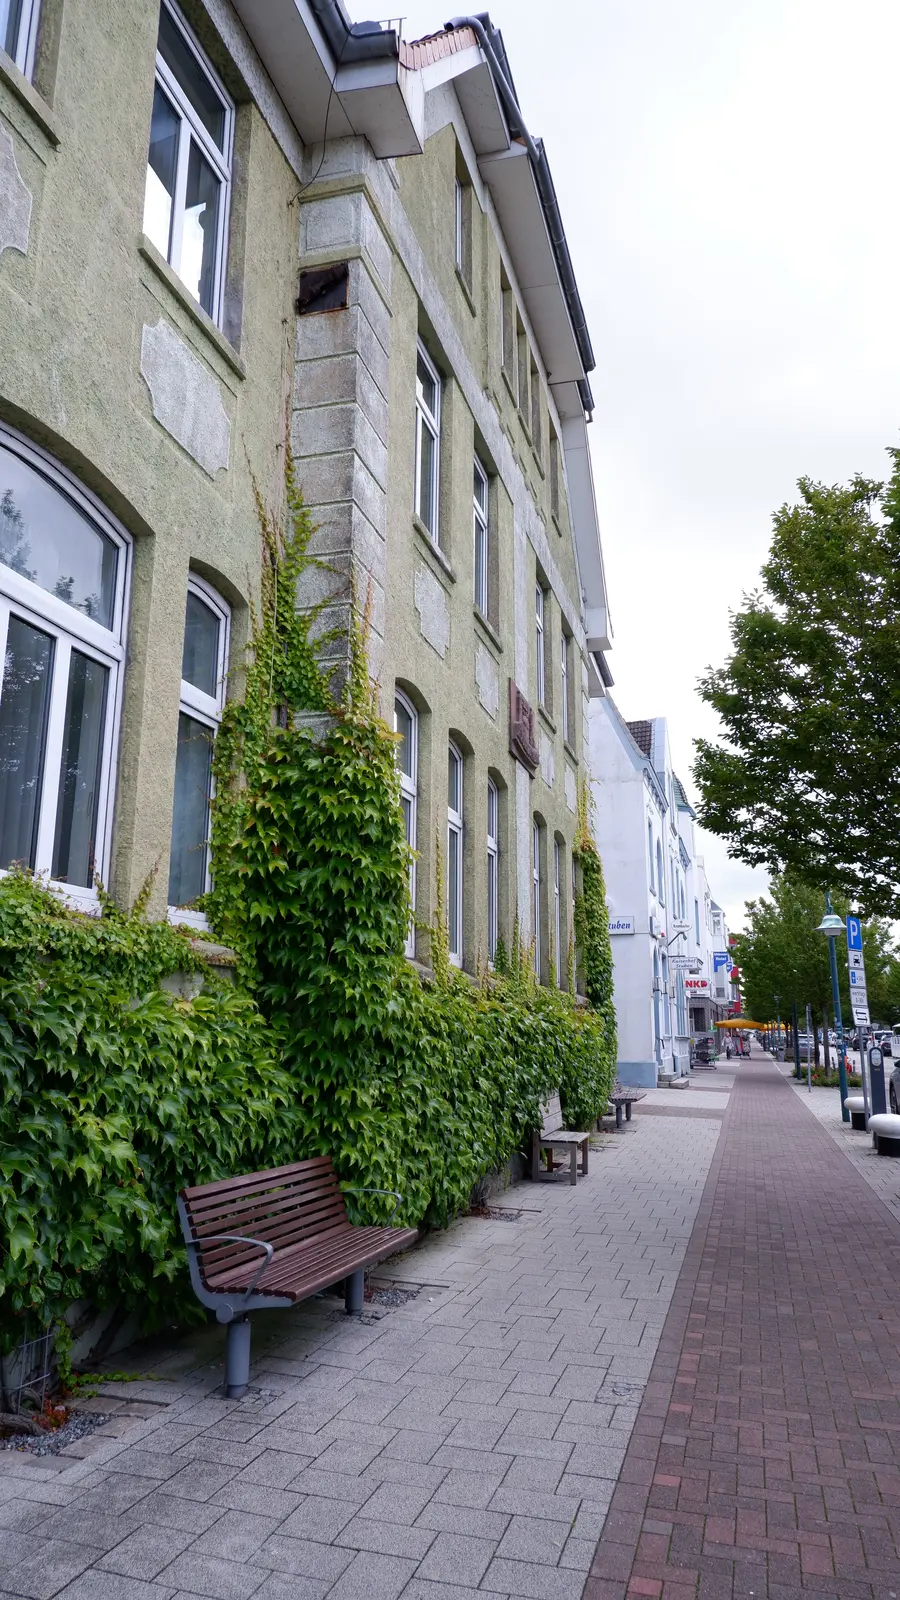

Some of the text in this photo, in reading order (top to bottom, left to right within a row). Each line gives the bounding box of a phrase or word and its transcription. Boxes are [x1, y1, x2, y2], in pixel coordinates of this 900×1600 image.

[608, 920, 631, 930] tuben
[850, 920, 858, 946] P
[685, 980, 708, 988] NKD
